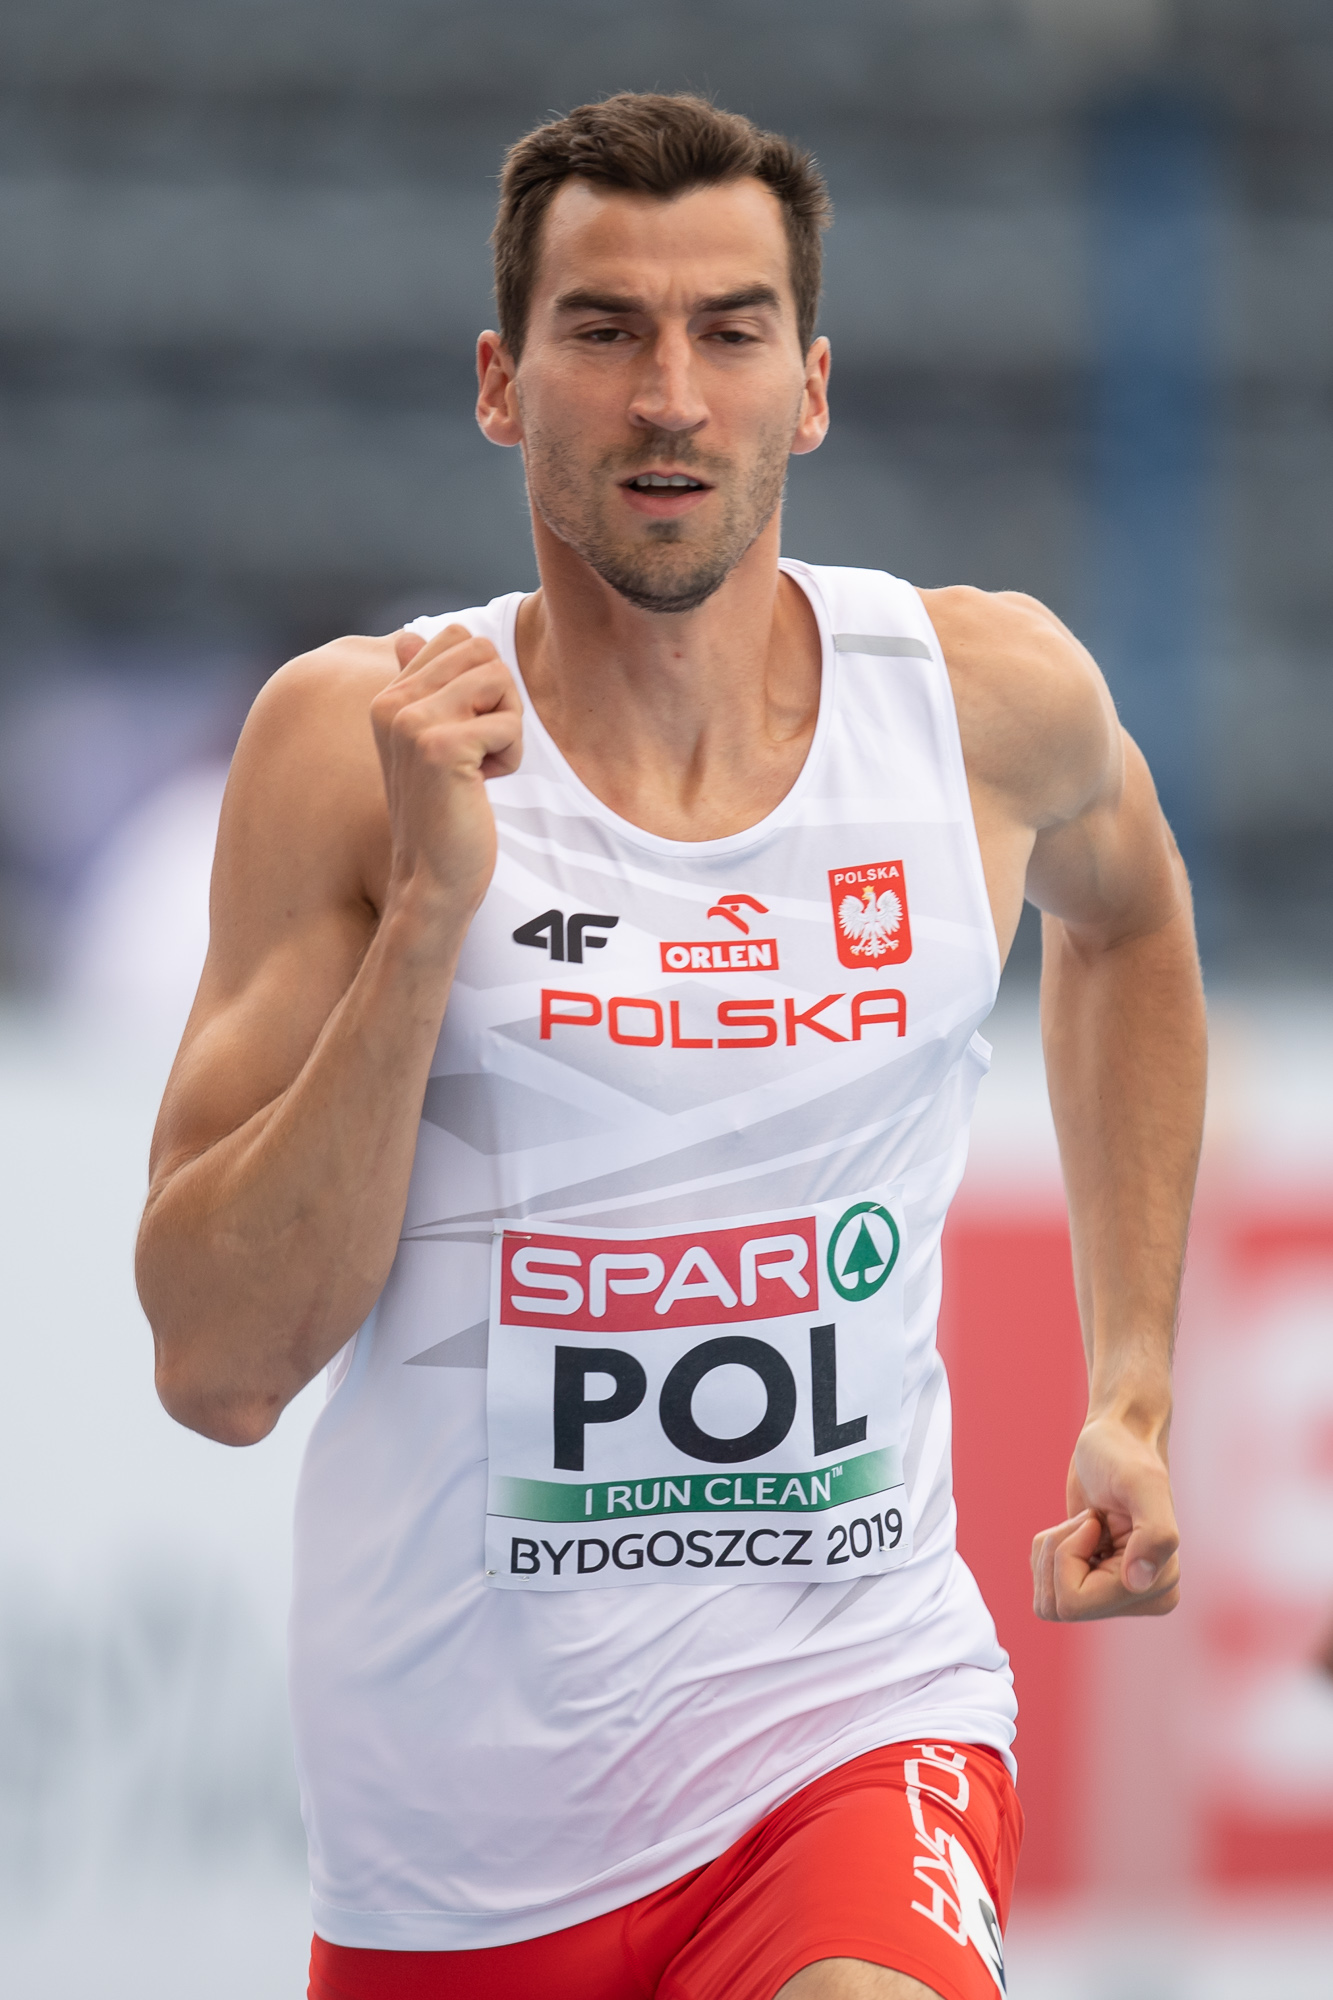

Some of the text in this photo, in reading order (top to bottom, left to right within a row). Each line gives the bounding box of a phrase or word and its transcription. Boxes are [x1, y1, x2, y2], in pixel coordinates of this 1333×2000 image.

[834, 865, 900, 886] POLSKA
[512, 909, 620, 964] 4F
[665, 944, 772, 969] ORLEN
[539, 988, 907, 1049] POLSKA
[510, 1233, 811, 1318] SPAR
[553, 1323, 868, 1471] POL
[584, 1488, 593, 1516] I
[607, 1479, 691, 1514] RUN
[510, 1508, 903, 1576] BYDGOSZCZ 2019
